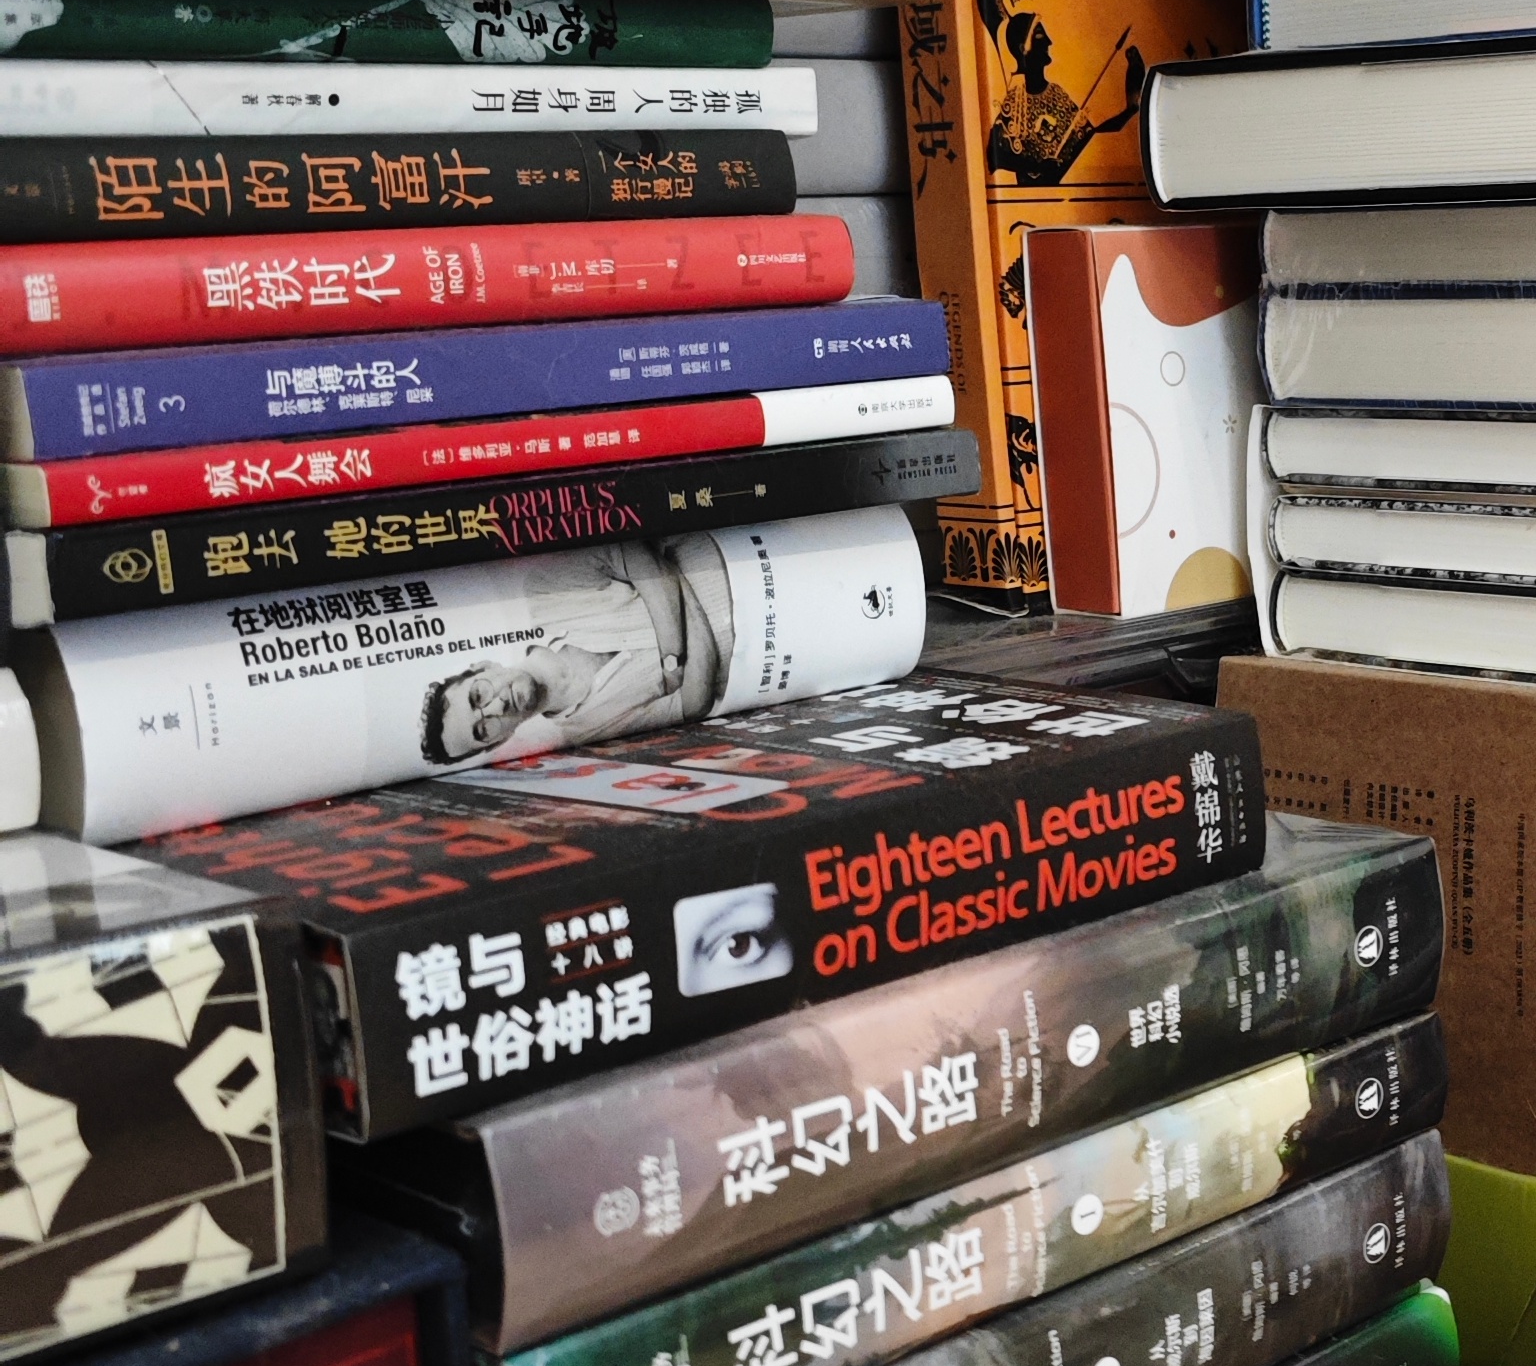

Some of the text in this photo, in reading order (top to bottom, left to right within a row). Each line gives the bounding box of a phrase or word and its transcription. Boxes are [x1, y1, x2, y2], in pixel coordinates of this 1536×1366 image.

[472, 88, 762, 115] 孤独的人 周身如月
[89, 148, 494, 221] 陌生的阿富汗
[599, 151, 698, 175] 一个女人的
[610, 176, 694, 202] 独行漫记
[202, 253, 400, 312] 黑铁时代
[423, 246, 444, 304] AGE OF
[450, 254, 464, 296] IRON
[158, 394, 186, 413] 3
[264, 359, 420, 398] 与魔搏斗的人
[204, 448, 372, 499] 疯女人舞会
[488, 482, 617, 517] ORPHEUS
[227, 581, 438, 637] 在地狱阅览室里
[240, 614, 448, 667] Roberto Bolaño
[247, 627, 545, 687] EN LA SALA DE LECTURAS DEL INFIERNO
[1189, 750, 1224, 864] 戴锦华
[804, 824, 1011, 920] Eighteen
[1018, 772, 1185, 838] Lectures
[545, 905, 630, 946] 经典电影
[812, 837, 1178, 976] on Classic Movies
[394, 932, 527, 1020] 镜与
[550, 936, 633, 976] 十八讲
[408, 972, 652, 1098] 世俗神话
[717, 1052, 979, 1207] 科幻之路
